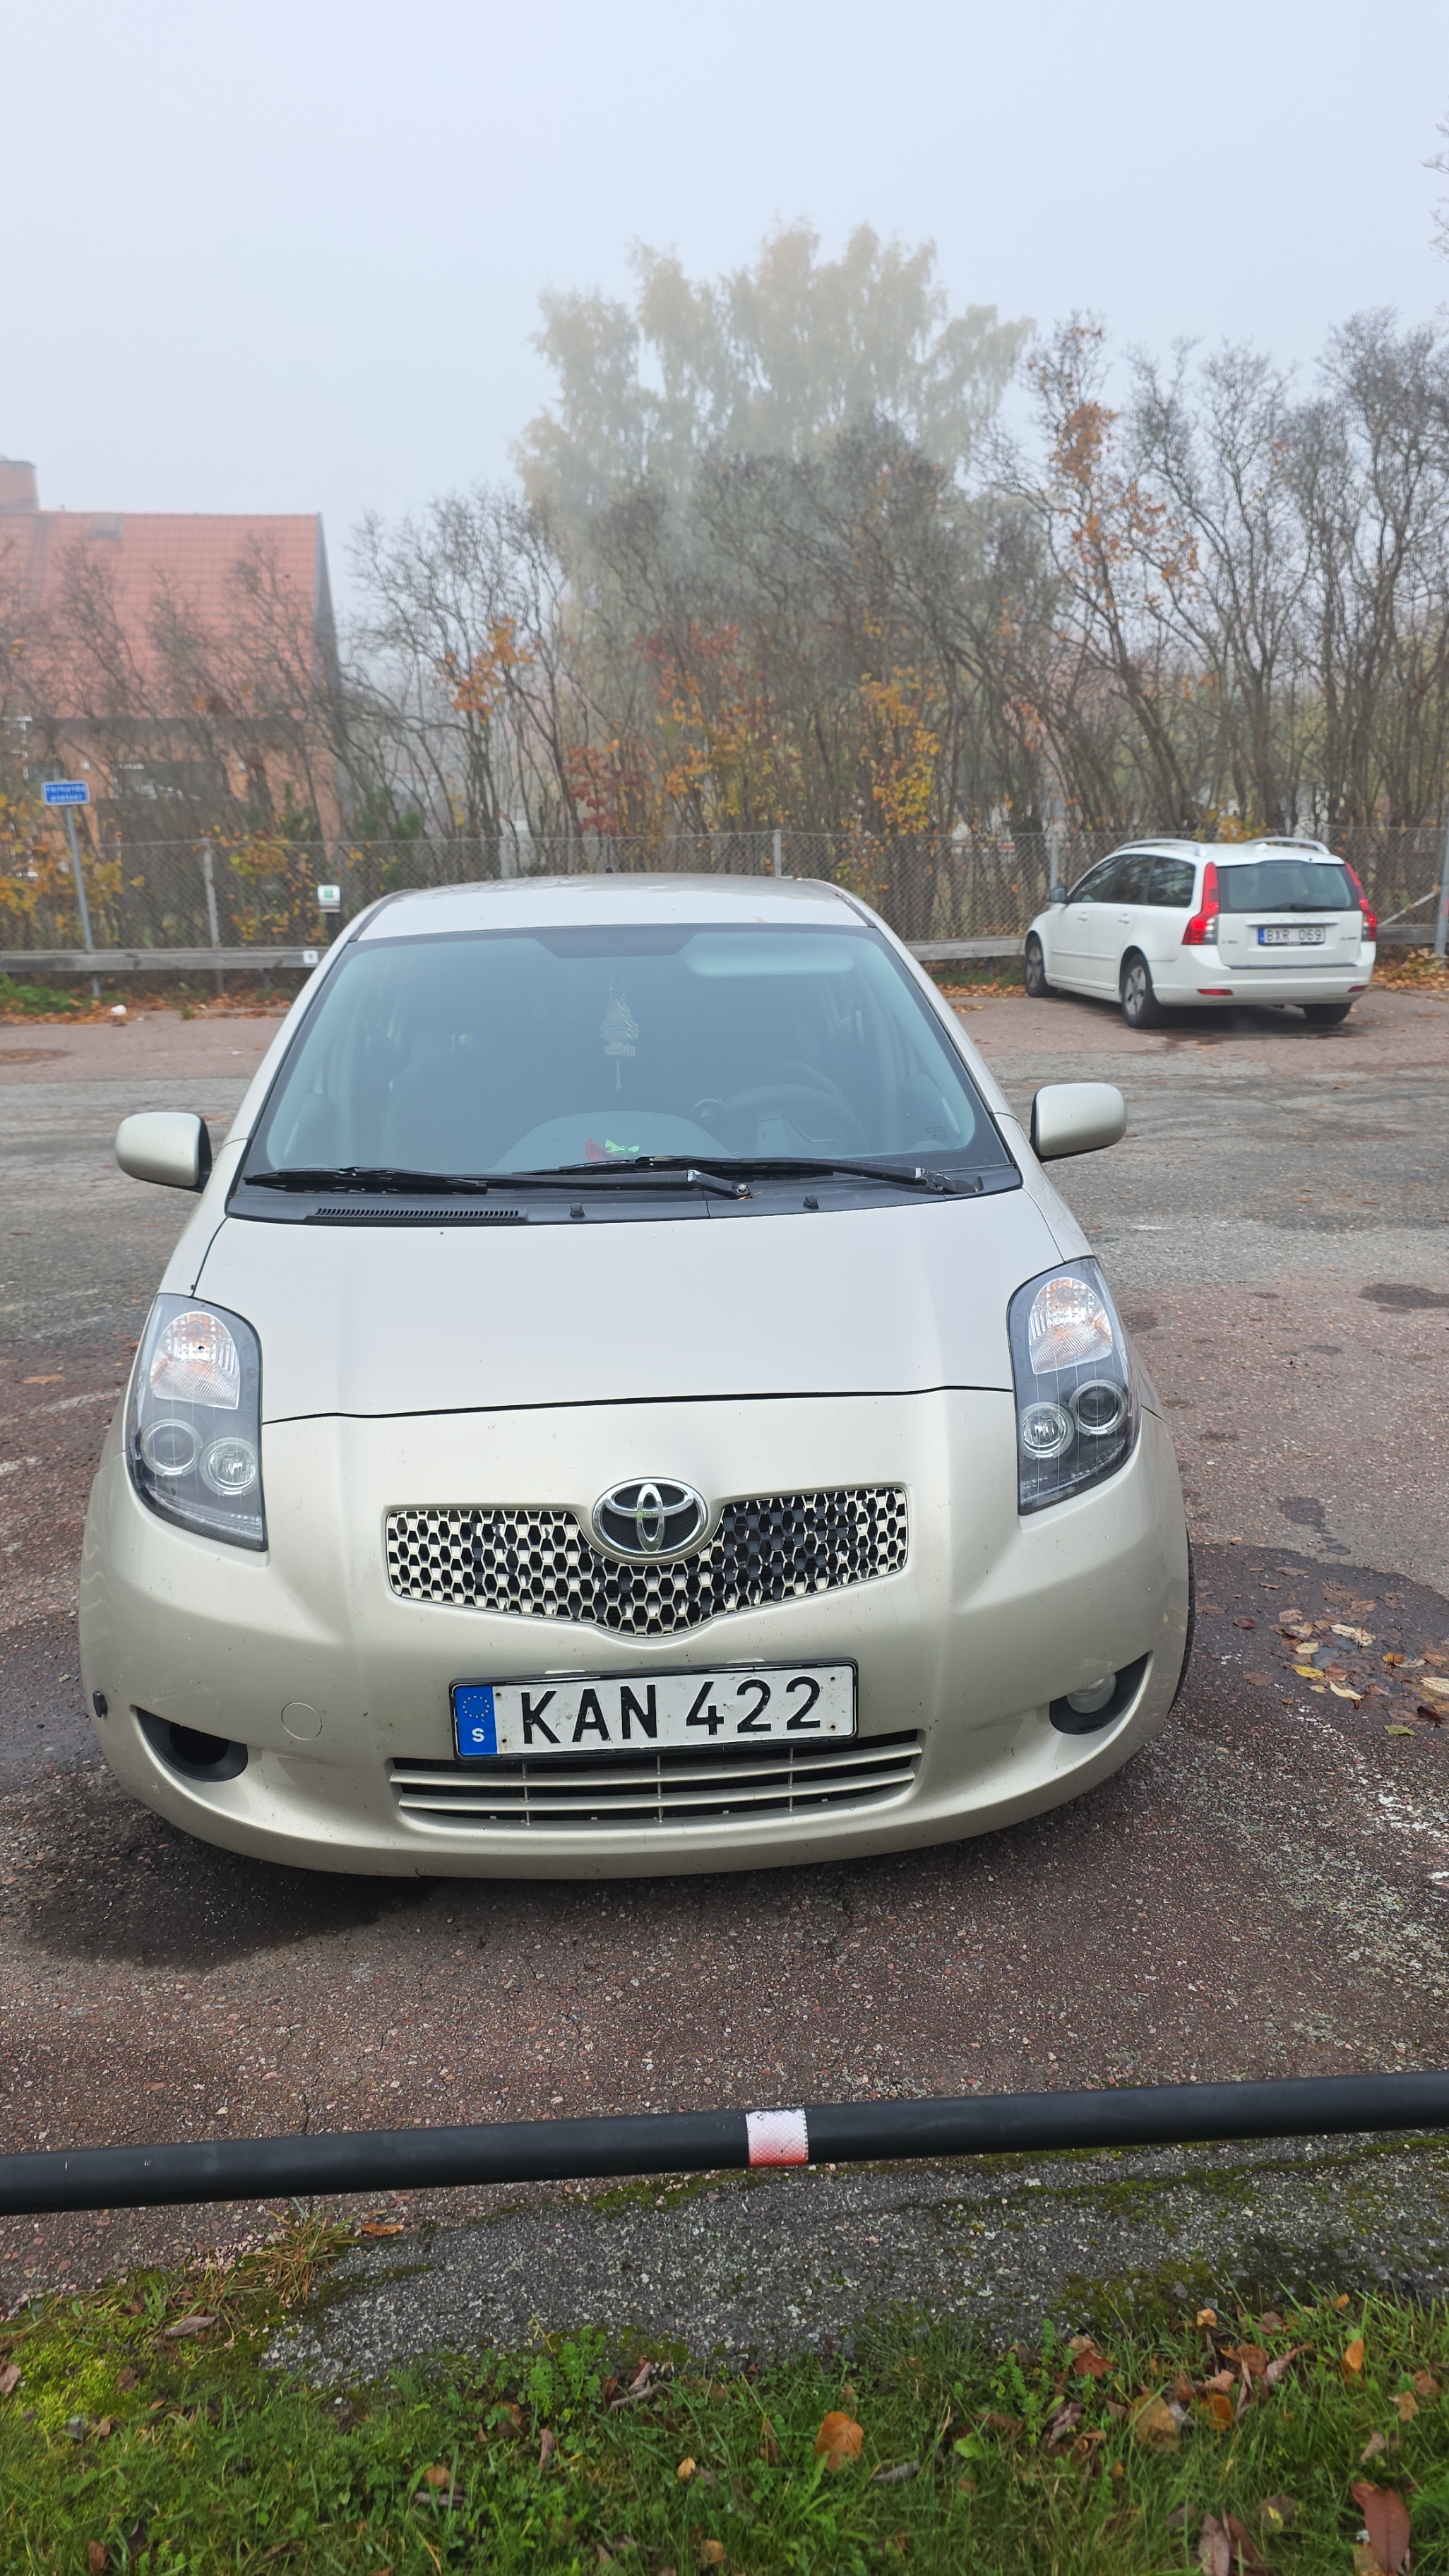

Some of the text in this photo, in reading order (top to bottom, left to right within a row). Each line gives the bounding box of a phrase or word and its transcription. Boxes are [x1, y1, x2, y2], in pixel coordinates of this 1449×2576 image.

[1268, 929, 1322, 941] BXR 069
[521, 1676, 821, 1744] KAN 422
[472, 1728, 484, 1742] S
